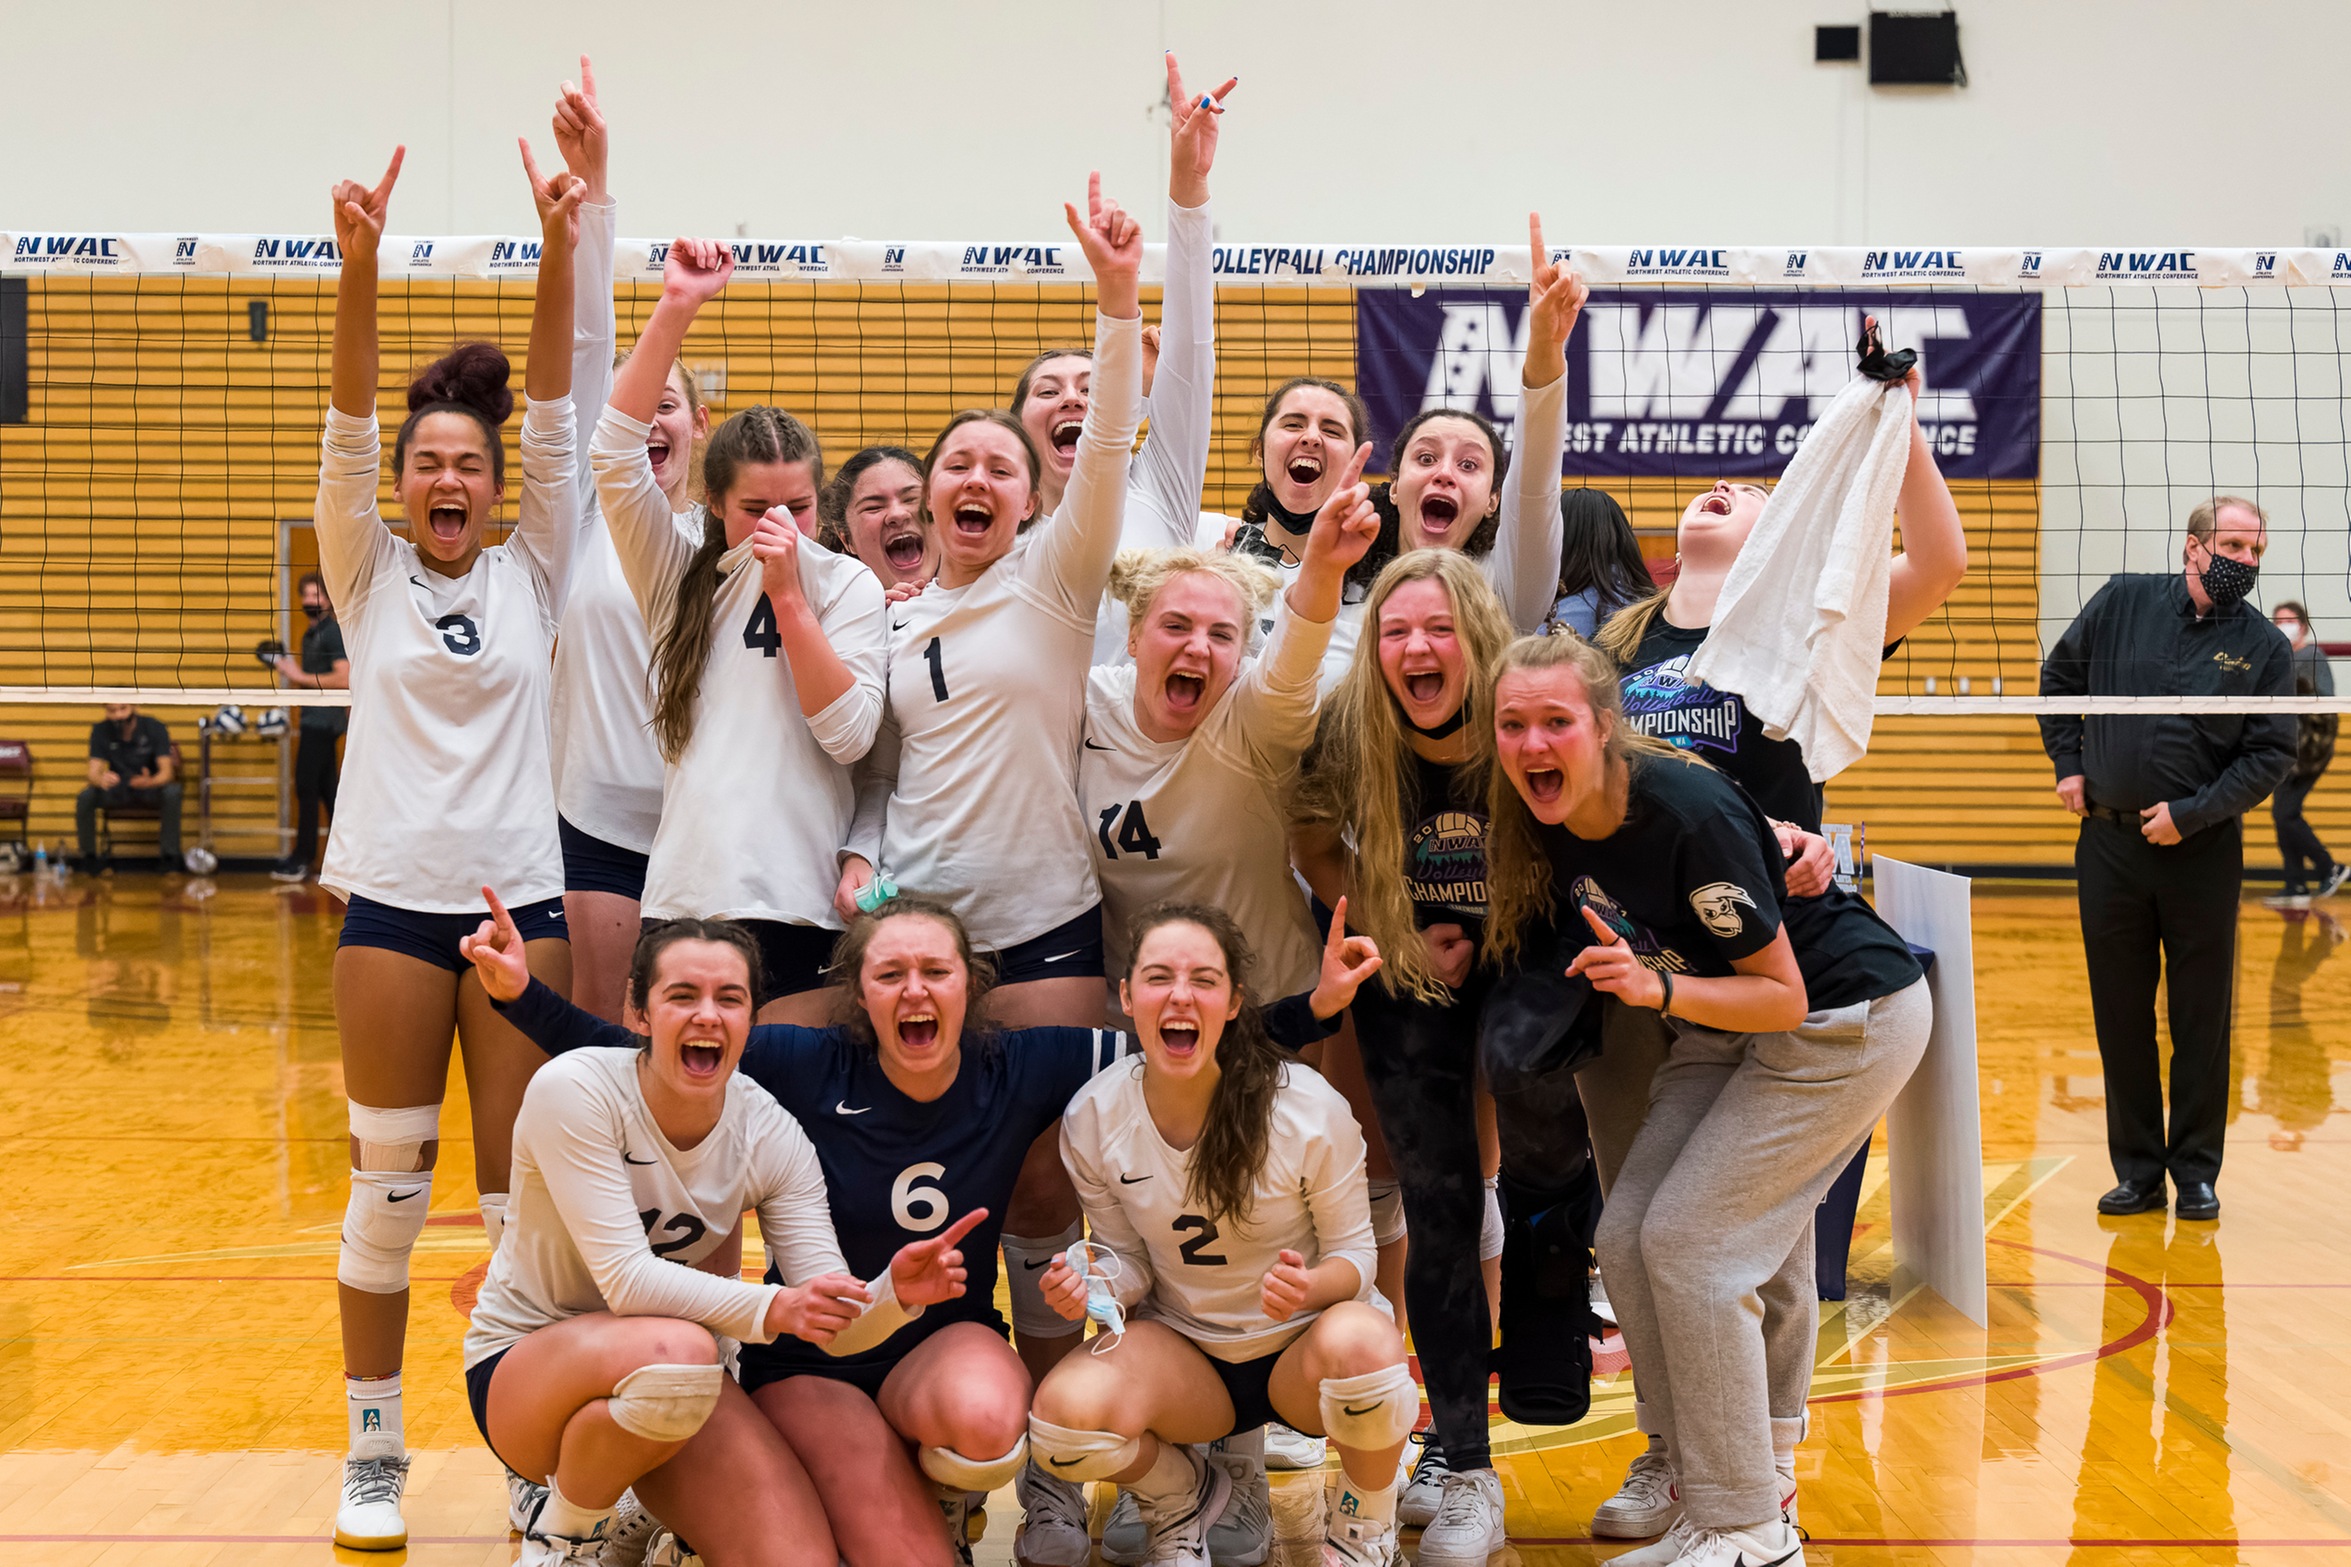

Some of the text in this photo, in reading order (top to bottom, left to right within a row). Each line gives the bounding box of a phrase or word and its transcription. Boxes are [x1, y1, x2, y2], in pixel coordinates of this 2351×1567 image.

[16, 237, 118, 257] NWAC
[255, 239, 343, 259] NWA
[492, 241, 544, 260] NW
[731, 244, 826, 264] NWAC
[963, 246, 1062, 266] NWAC
[1628, 249, 1728, 268] NWAC
[1863, 251, 1963, 270] NWAC
[1212, 248, 1495, 276] OLLEYBALL CHAMPIONSHIP
[2098, 252, 2197, 271] NWAC
[1420, 301, 1978, 421] NWAC
[1618, 422, 1766, 455] ATHLETIC
[435, 614, 481, 656] 3
[743, 590, 782, 657] 4
[923, 636, 949, 703] 1
[1629, 700, 1737, 741] MPIONSHIP
[1098, 800, 1162, 860] 14
[1428, 837, 1488, 852] NWA
[1417, 863, 1488, 882] Volley
[1402, 874, 1488, 903] CHAMPIO
[891, 1161, 950, 1233] 6
[1171, 1214, 1229, 1266] 2
